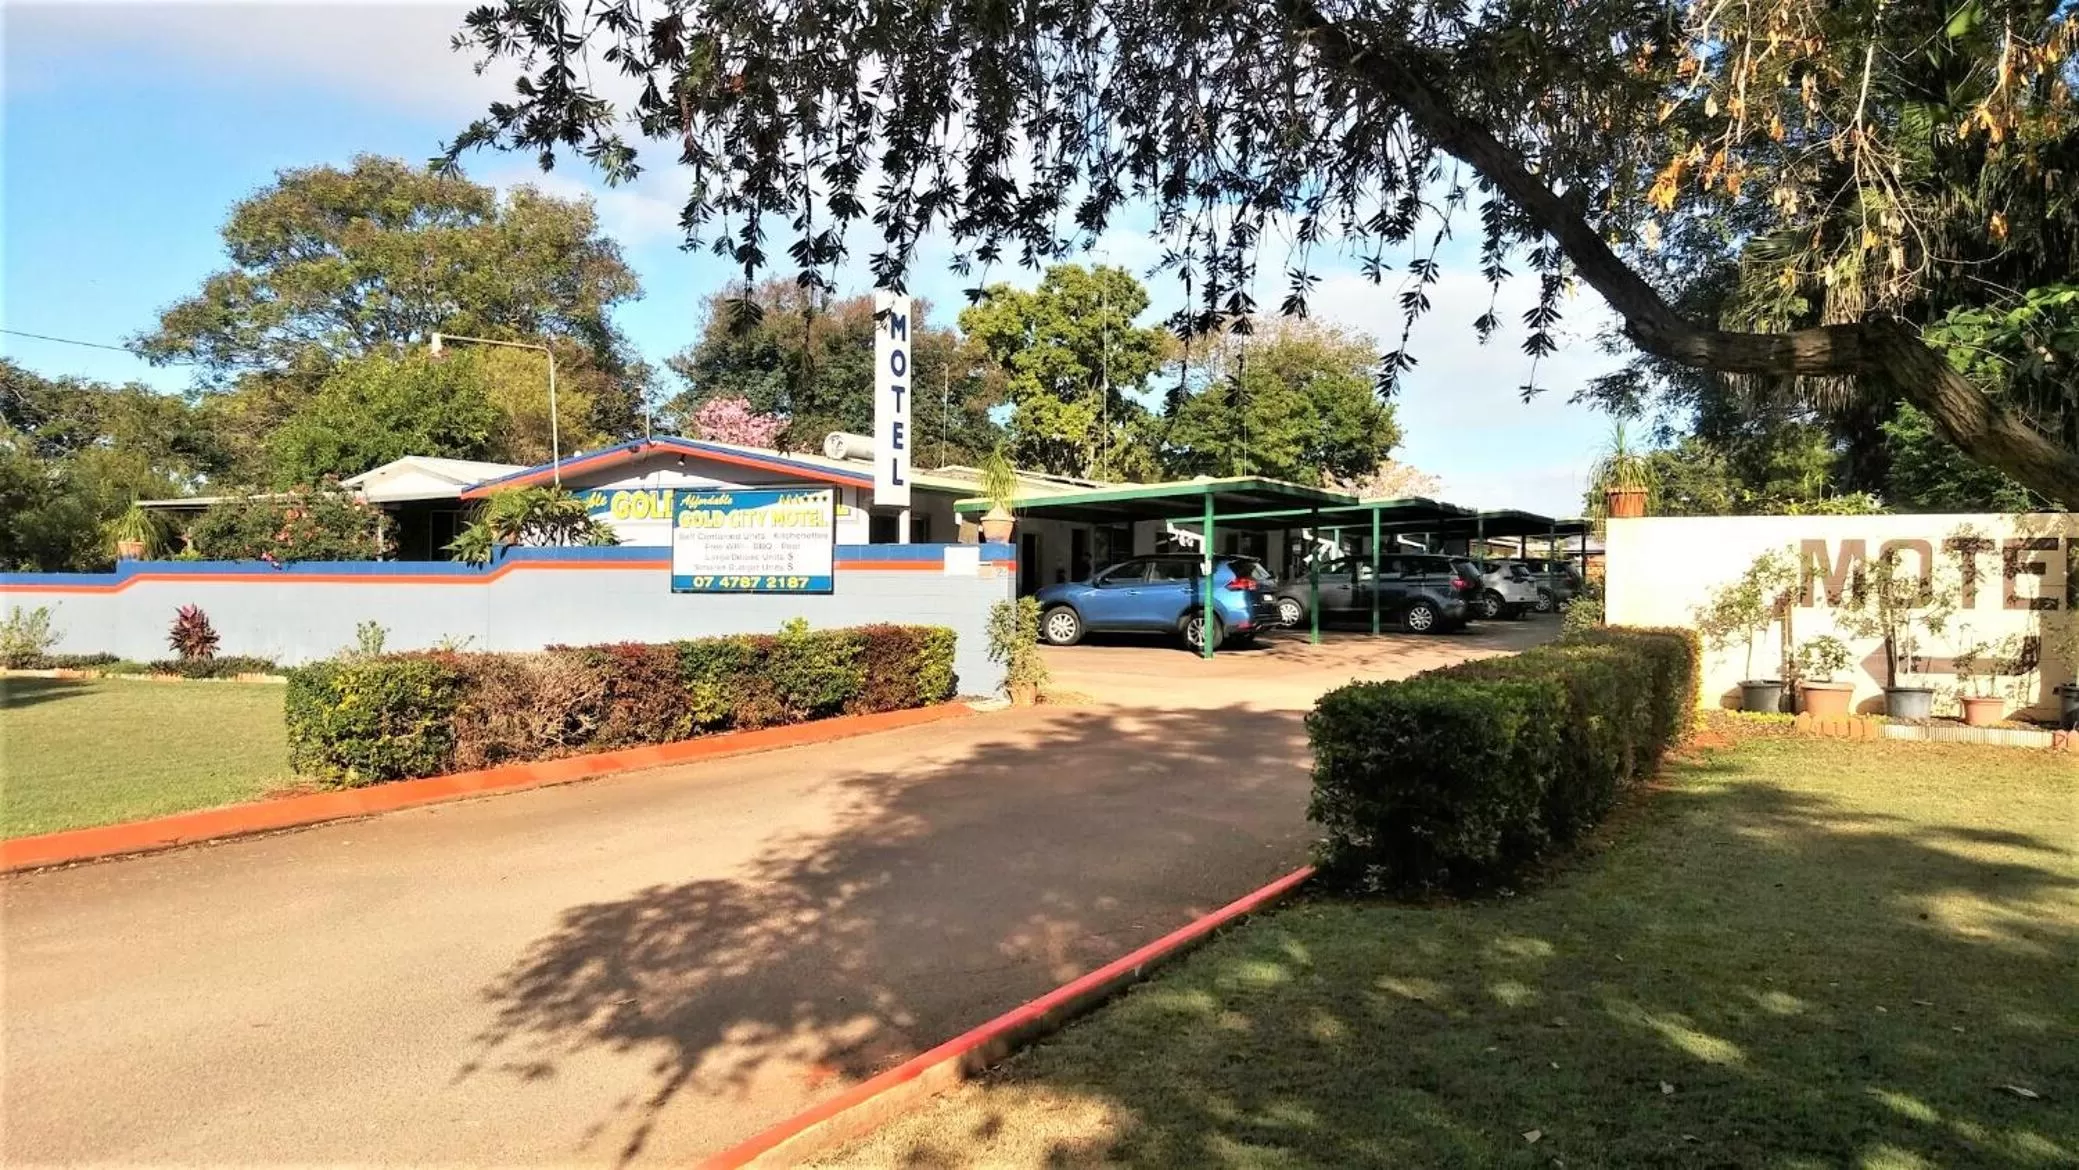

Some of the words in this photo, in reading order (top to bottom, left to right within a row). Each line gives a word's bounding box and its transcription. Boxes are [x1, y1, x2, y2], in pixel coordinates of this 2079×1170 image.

[890, 312, 907, 486] MOTEL
[680, 494, 733, 509] Affordable
[679, 510, 724, 528] GOLD
[729, 509, 769, 528] CITY
[771, 508, 829, 528] MOTEL
[693, 576, 714, 588] 07
[719, 576, 761, 588] 4787
[766, 576, 809, 588] 2187
[1800, 537, 2079, 611] MOTE
